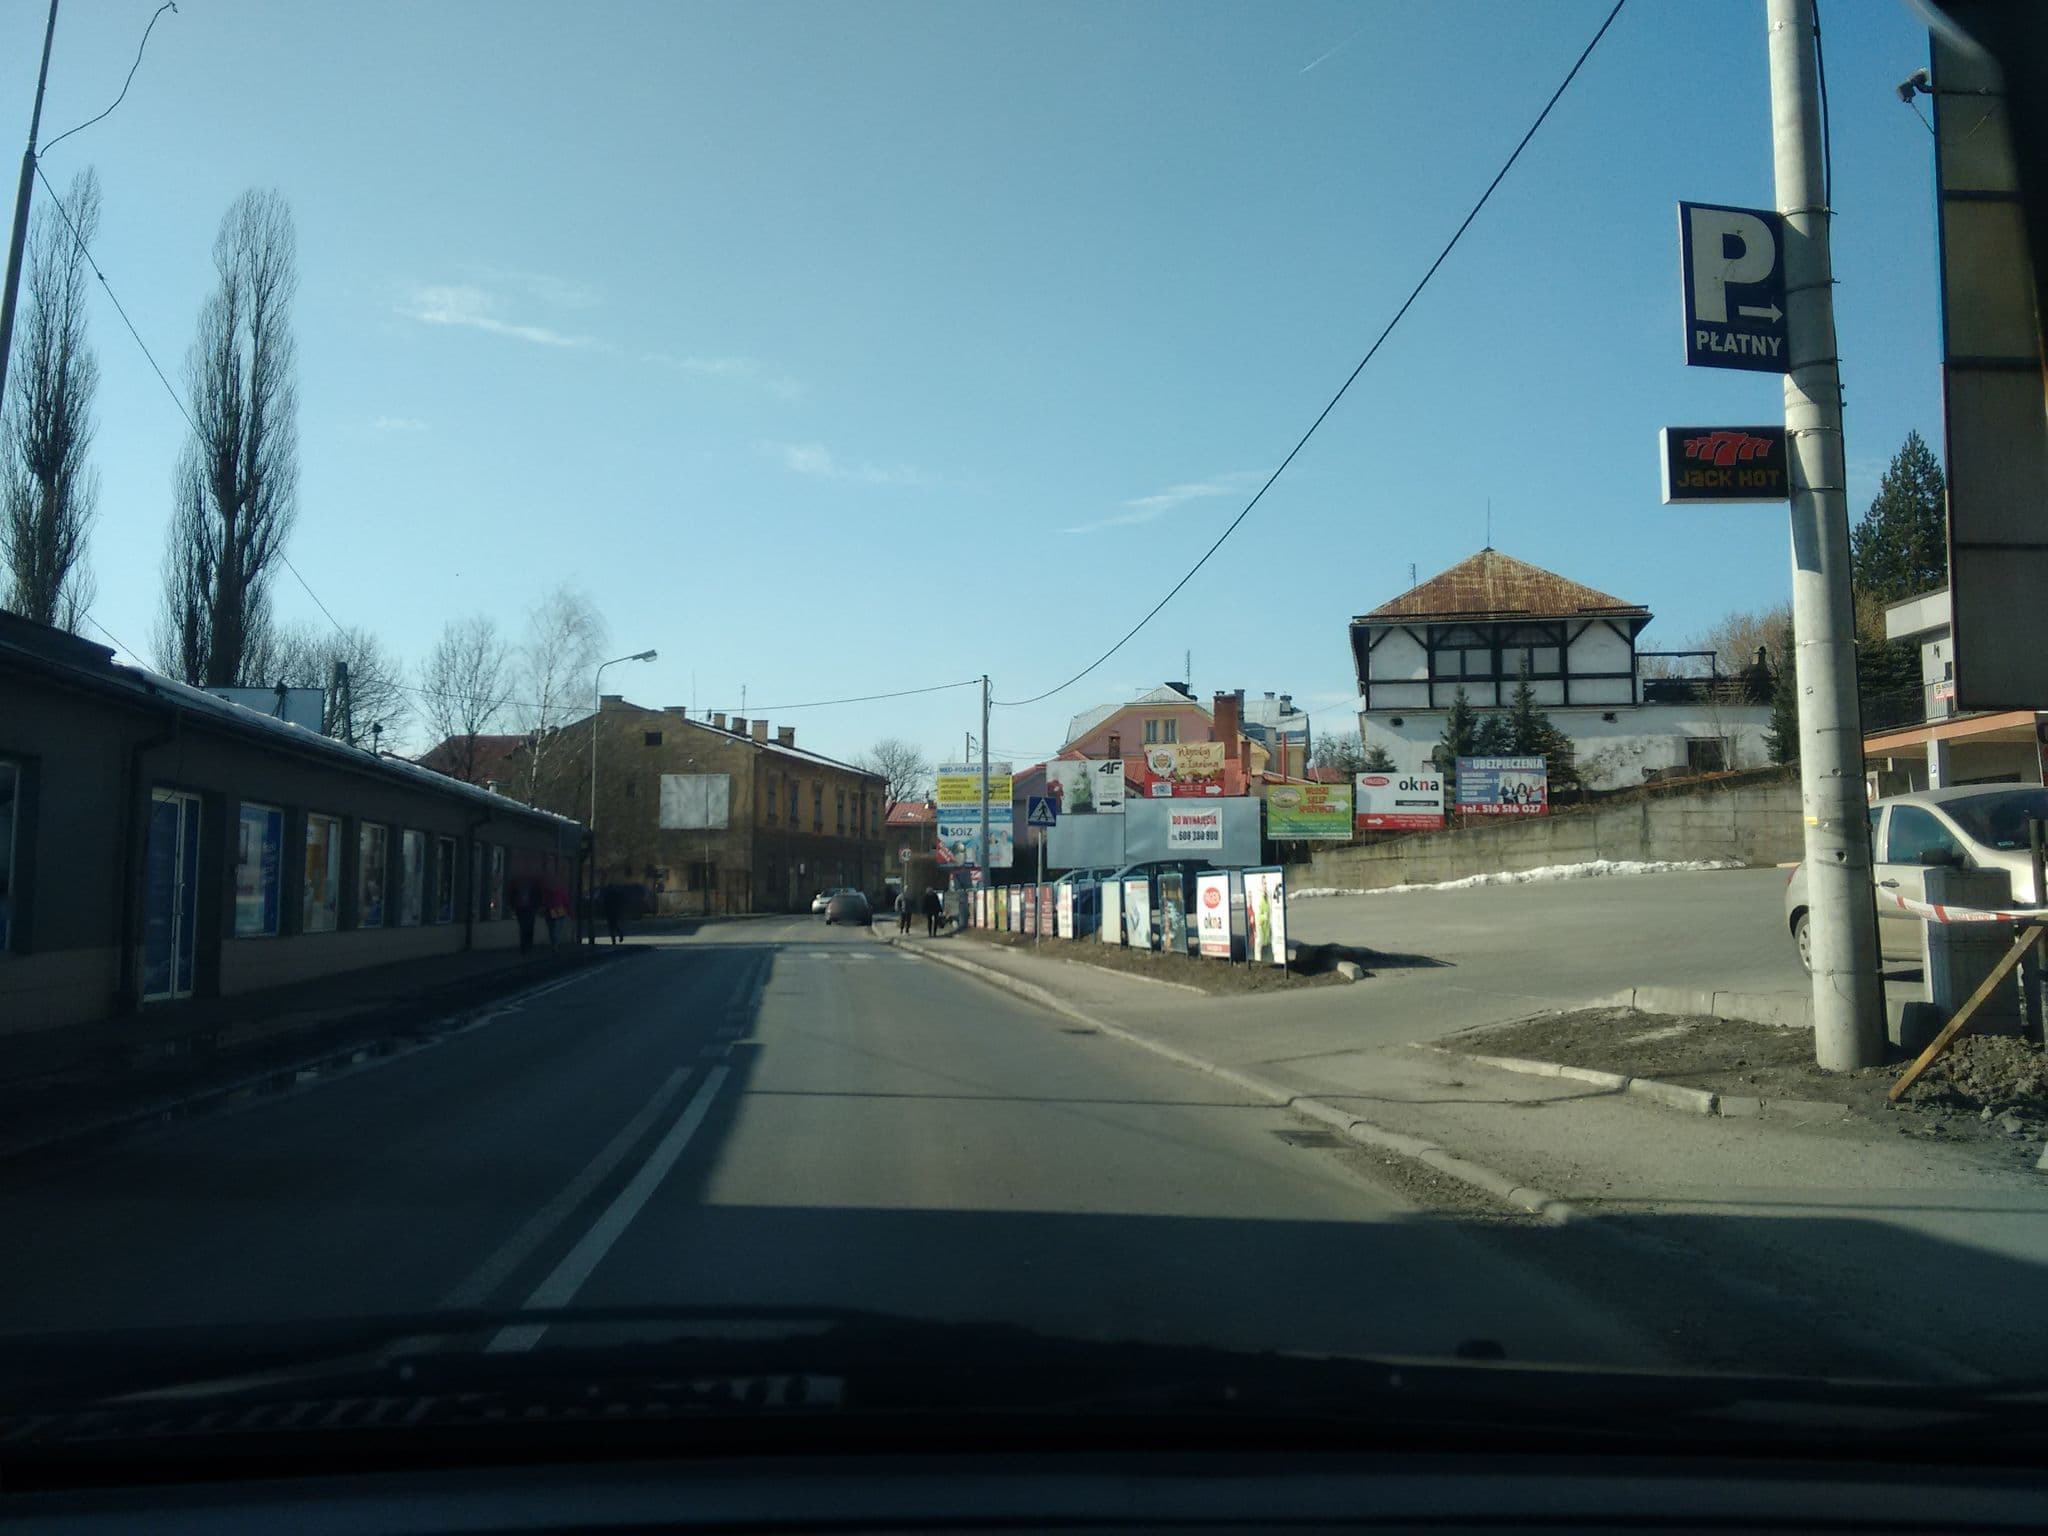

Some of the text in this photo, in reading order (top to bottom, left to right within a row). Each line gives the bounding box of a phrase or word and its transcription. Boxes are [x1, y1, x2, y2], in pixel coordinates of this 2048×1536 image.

[1690, 208, 1776, 323] P
[1696, 330, 1782, 357] PŁATNY
[1472, 758, 1544, 769] UBEZPIECZENIA
[1398, 776, 1440, 791] okna
[1462, 804, 1541, 813] tel. 516 516 027
[1204, 913, 1222, 930] okna
